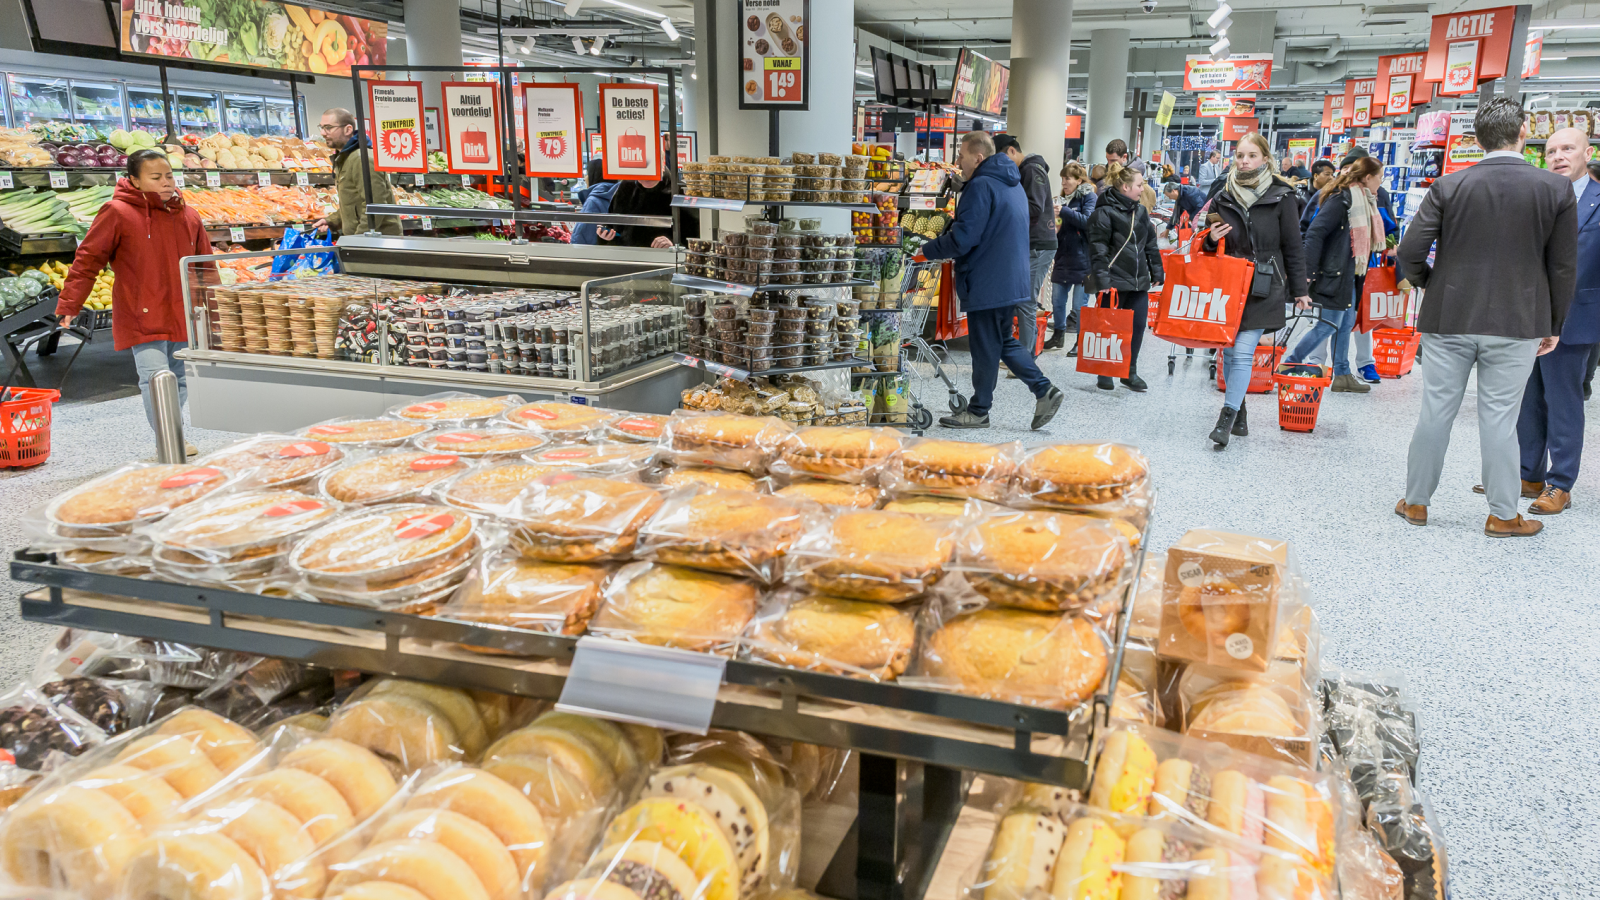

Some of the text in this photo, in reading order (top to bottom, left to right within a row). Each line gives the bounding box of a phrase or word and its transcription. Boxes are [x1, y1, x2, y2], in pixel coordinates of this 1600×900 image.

[135, 0, 201, 21] Dirk houdt
[134, 18, 228, 45] vers voordelig!
[1446, 13, 1495, 38] ACTIE
[773, 60, 792, 68] VANAF
[1389, 56, 1423, 73] ACTIE
[1452, 69, 1468, 84] 3.99
[770, 72, 795, 97] 1.49
[1354, 81, 1375, 94] ACTI
[460, 95, 481, 106] Altijd
[612, 97, 648, 107] De beste
[1331, 97, 1344, 107] ACT
[452, 107, 492, 117] voordelig!
[616, 109, 645, 120] acties!
[382, 120, 414, 129] STUNTPRIJS
[390, 132, 412, 155] 99
[464, 143, 485, 156] Dirk
[545, 139, 561, 155] 79
[621, 147, 643, 161] Dirk
[1168, 284, 1230, 322] Dirk
[1370, 291, 1404, 318] Dir
[1083, 332, 1123, 360] Dirk
